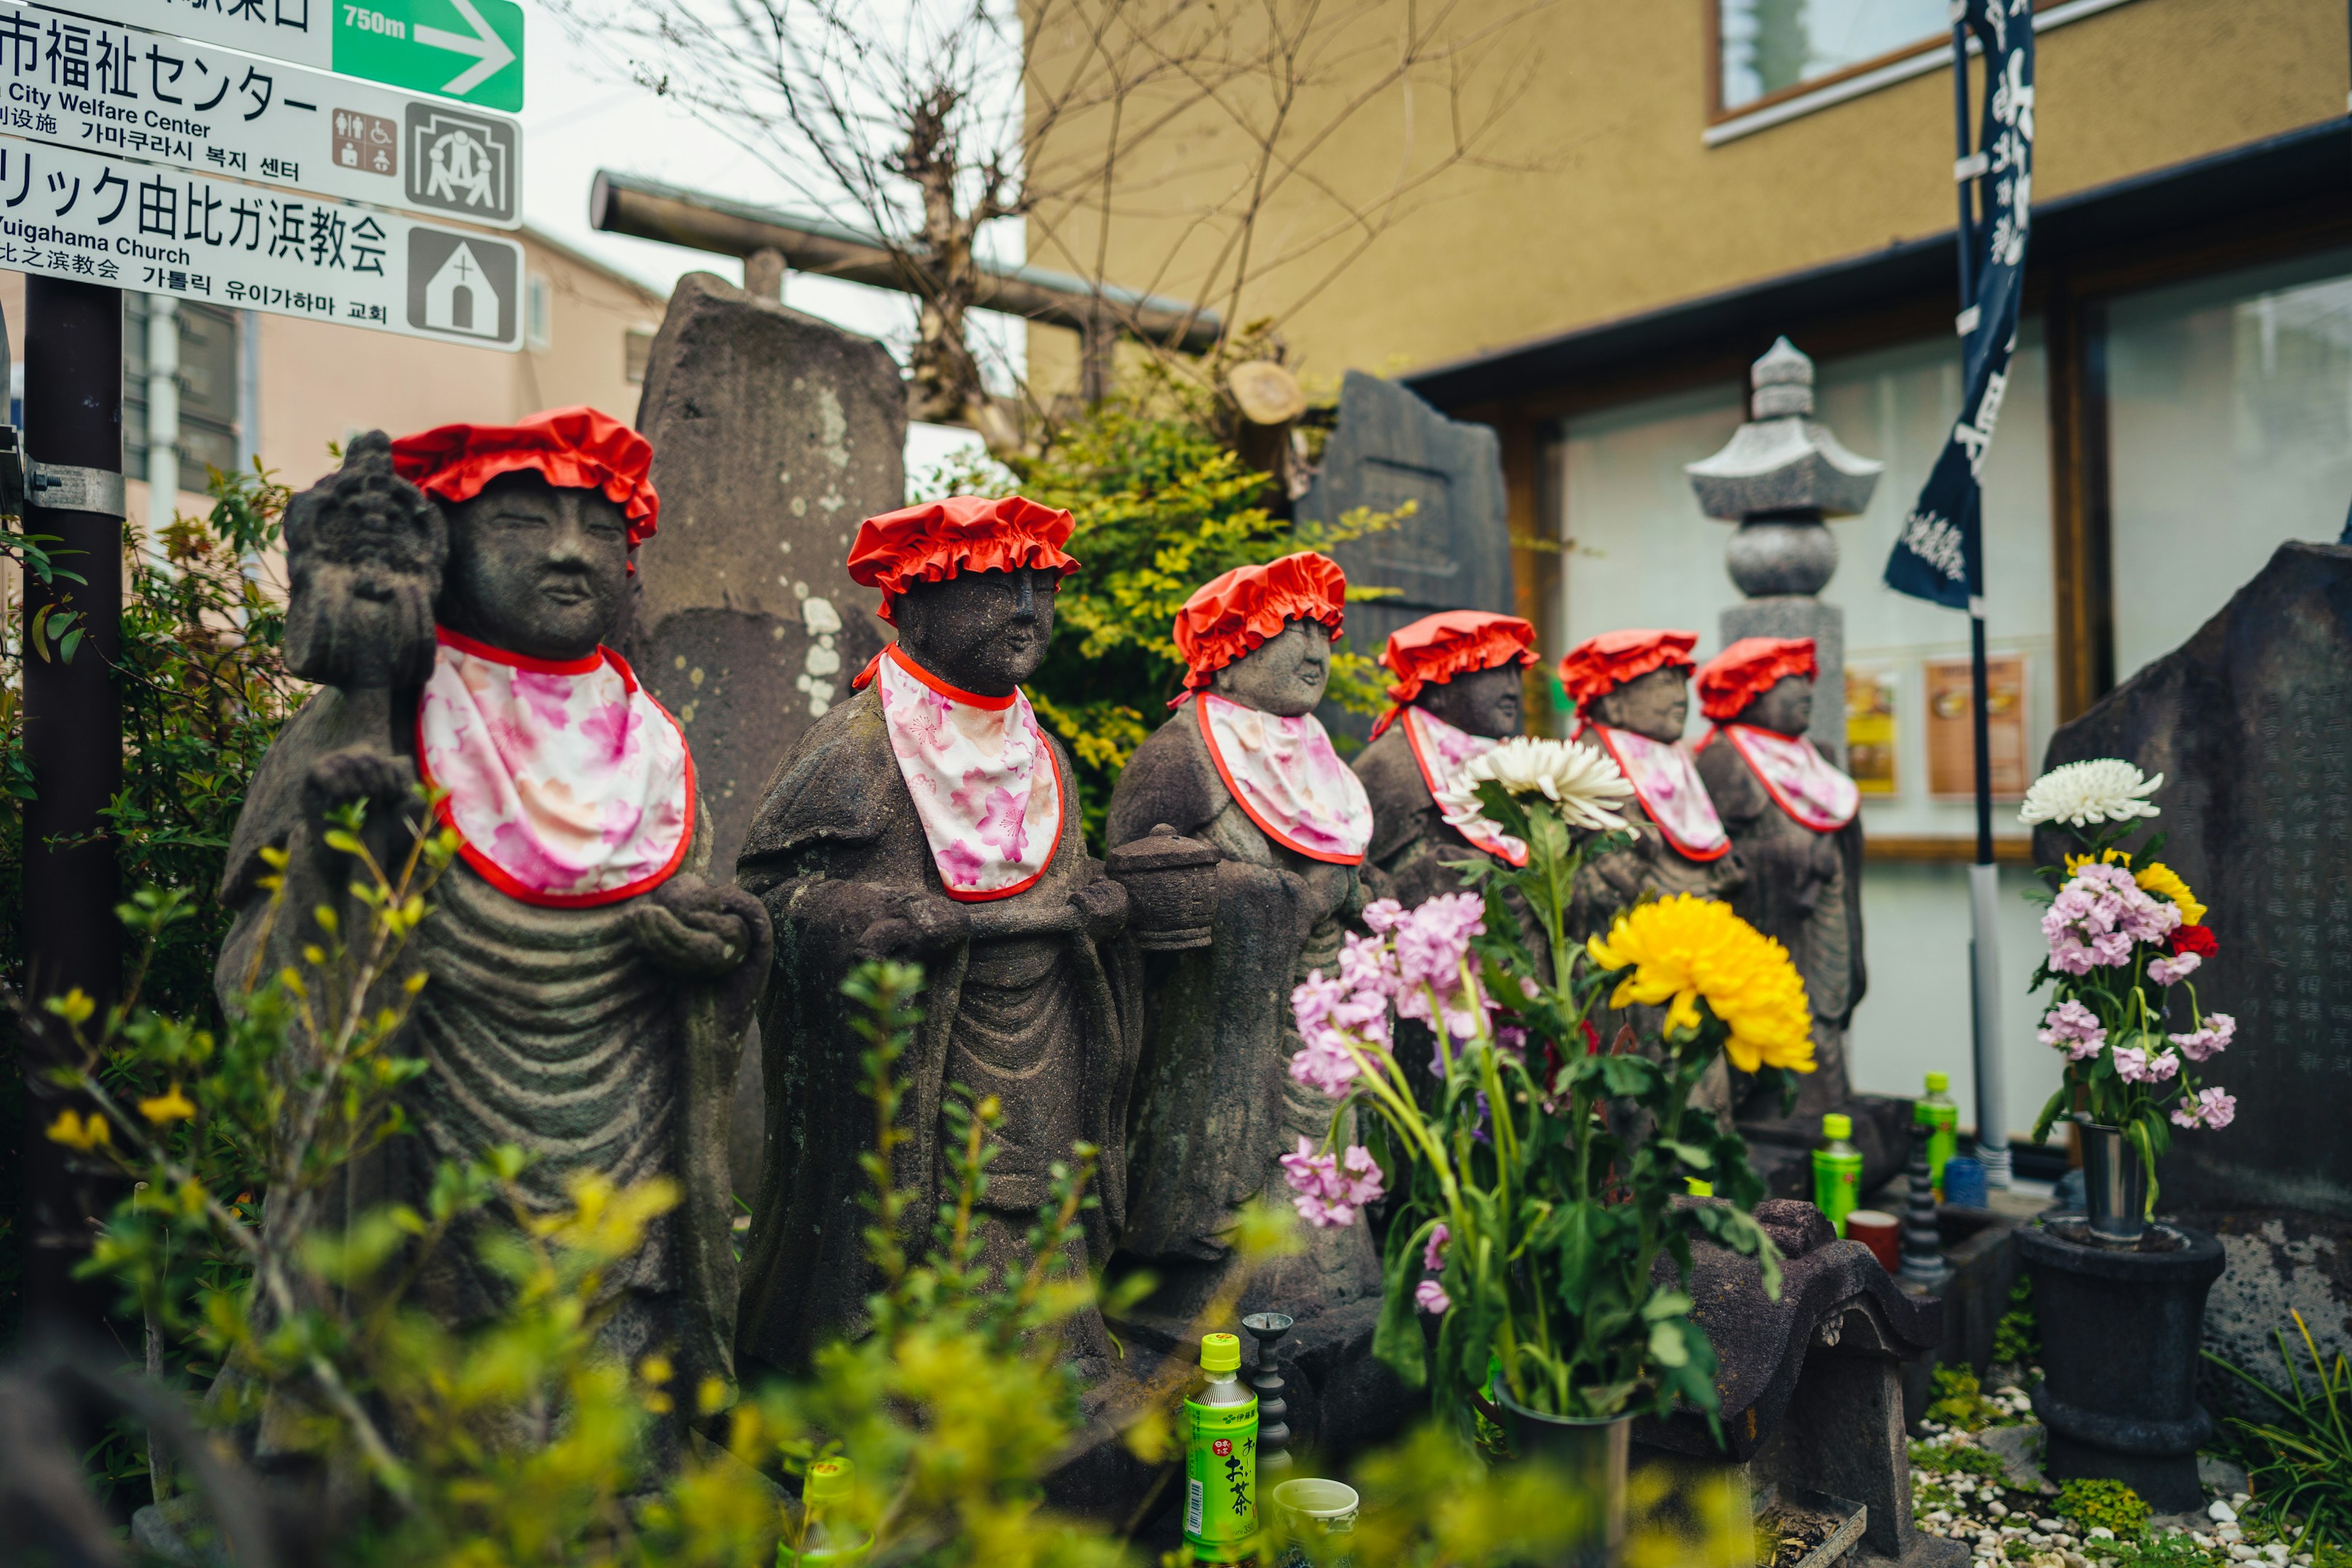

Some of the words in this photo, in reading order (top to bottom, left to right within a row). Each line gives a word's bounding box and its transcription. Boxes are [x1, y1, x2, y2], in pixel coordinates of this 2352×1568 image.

[343, 4, 406, 40] 750m
[0, 10, 317, 121] 市福祉センター
[9, 83, 52, 110] City
[59, 91, 138, 124] Welfare
[144, 110, 211, 138] Center
[81, 122, 192, 162] 가마쿠라시
[205, 146, 247, 172] 복지
[260, 157, 299, 182] 센터
[1, 149, 387, 277] リック由比ガ浜教会
[116, 237, 191, 266] Church
[143, 266, 211, 295] 가톨릭
[226, 280, 336, 316] 유이가하마
[347, 301, 387, 324] 교회
[1225, 1455, 1252, 1516] お茶
